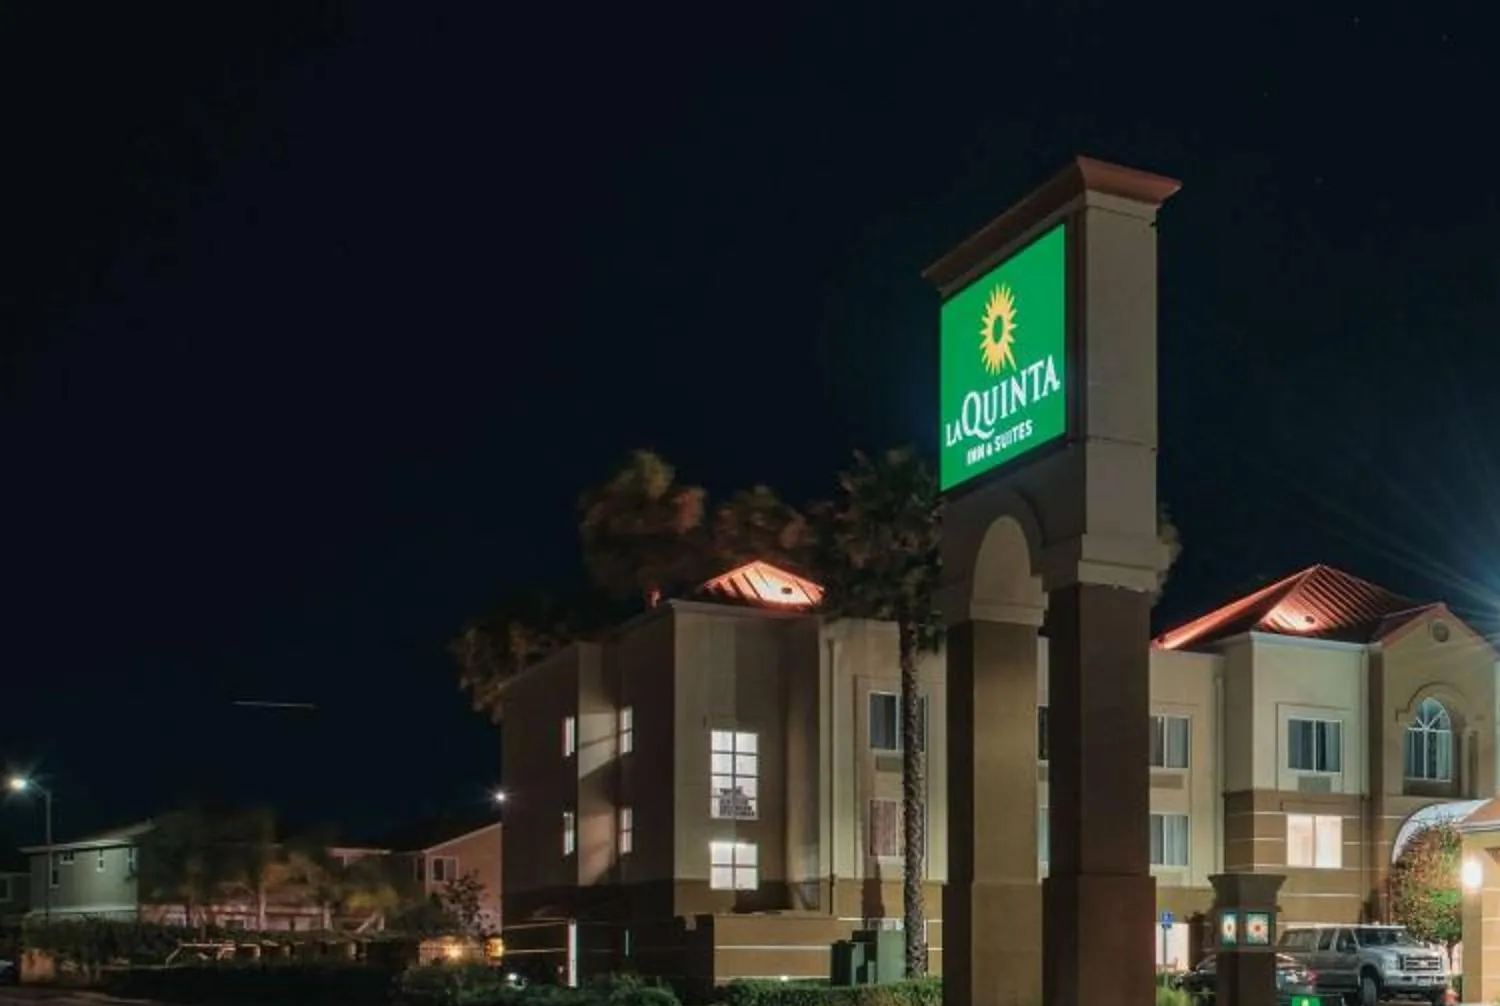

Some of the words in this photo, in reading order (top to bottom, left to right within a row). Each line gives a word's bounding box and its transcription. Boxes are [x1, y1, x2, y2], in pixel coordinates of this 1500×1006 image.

[946, 419, 963, 447] LA
[962, 354, 1060, 440] QUINTA
[994, 419, 1033, 452] SUITES
